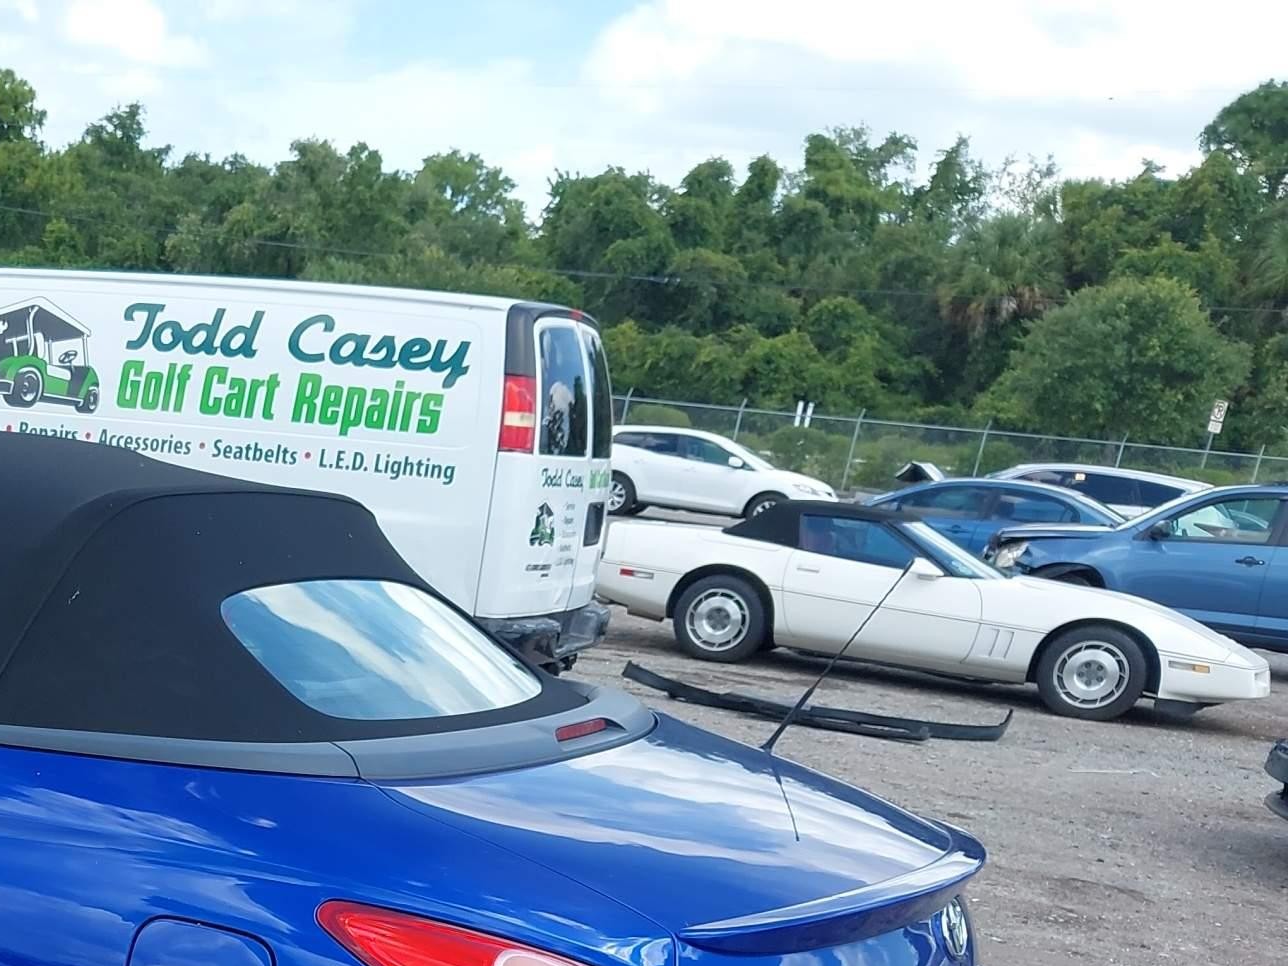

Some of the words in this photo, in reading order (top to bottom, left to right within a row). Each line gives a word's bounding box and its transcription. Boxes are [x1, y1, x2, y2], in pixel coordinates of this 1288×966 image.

[124, 303, 265, 359] Todd
[288, 314, 472, 389] Casey
[117, 360, 193, 412] Golf
[199, 366, 280, 420] Cart
[291, 372, 445, 437] Repairs
[98, 429, 192, 455] Accessories
[212, 439, 298, 465] Seatbelts
[319, 449, 368, 472] L.E.D.
[374, 453, 456, 485] Lighting
